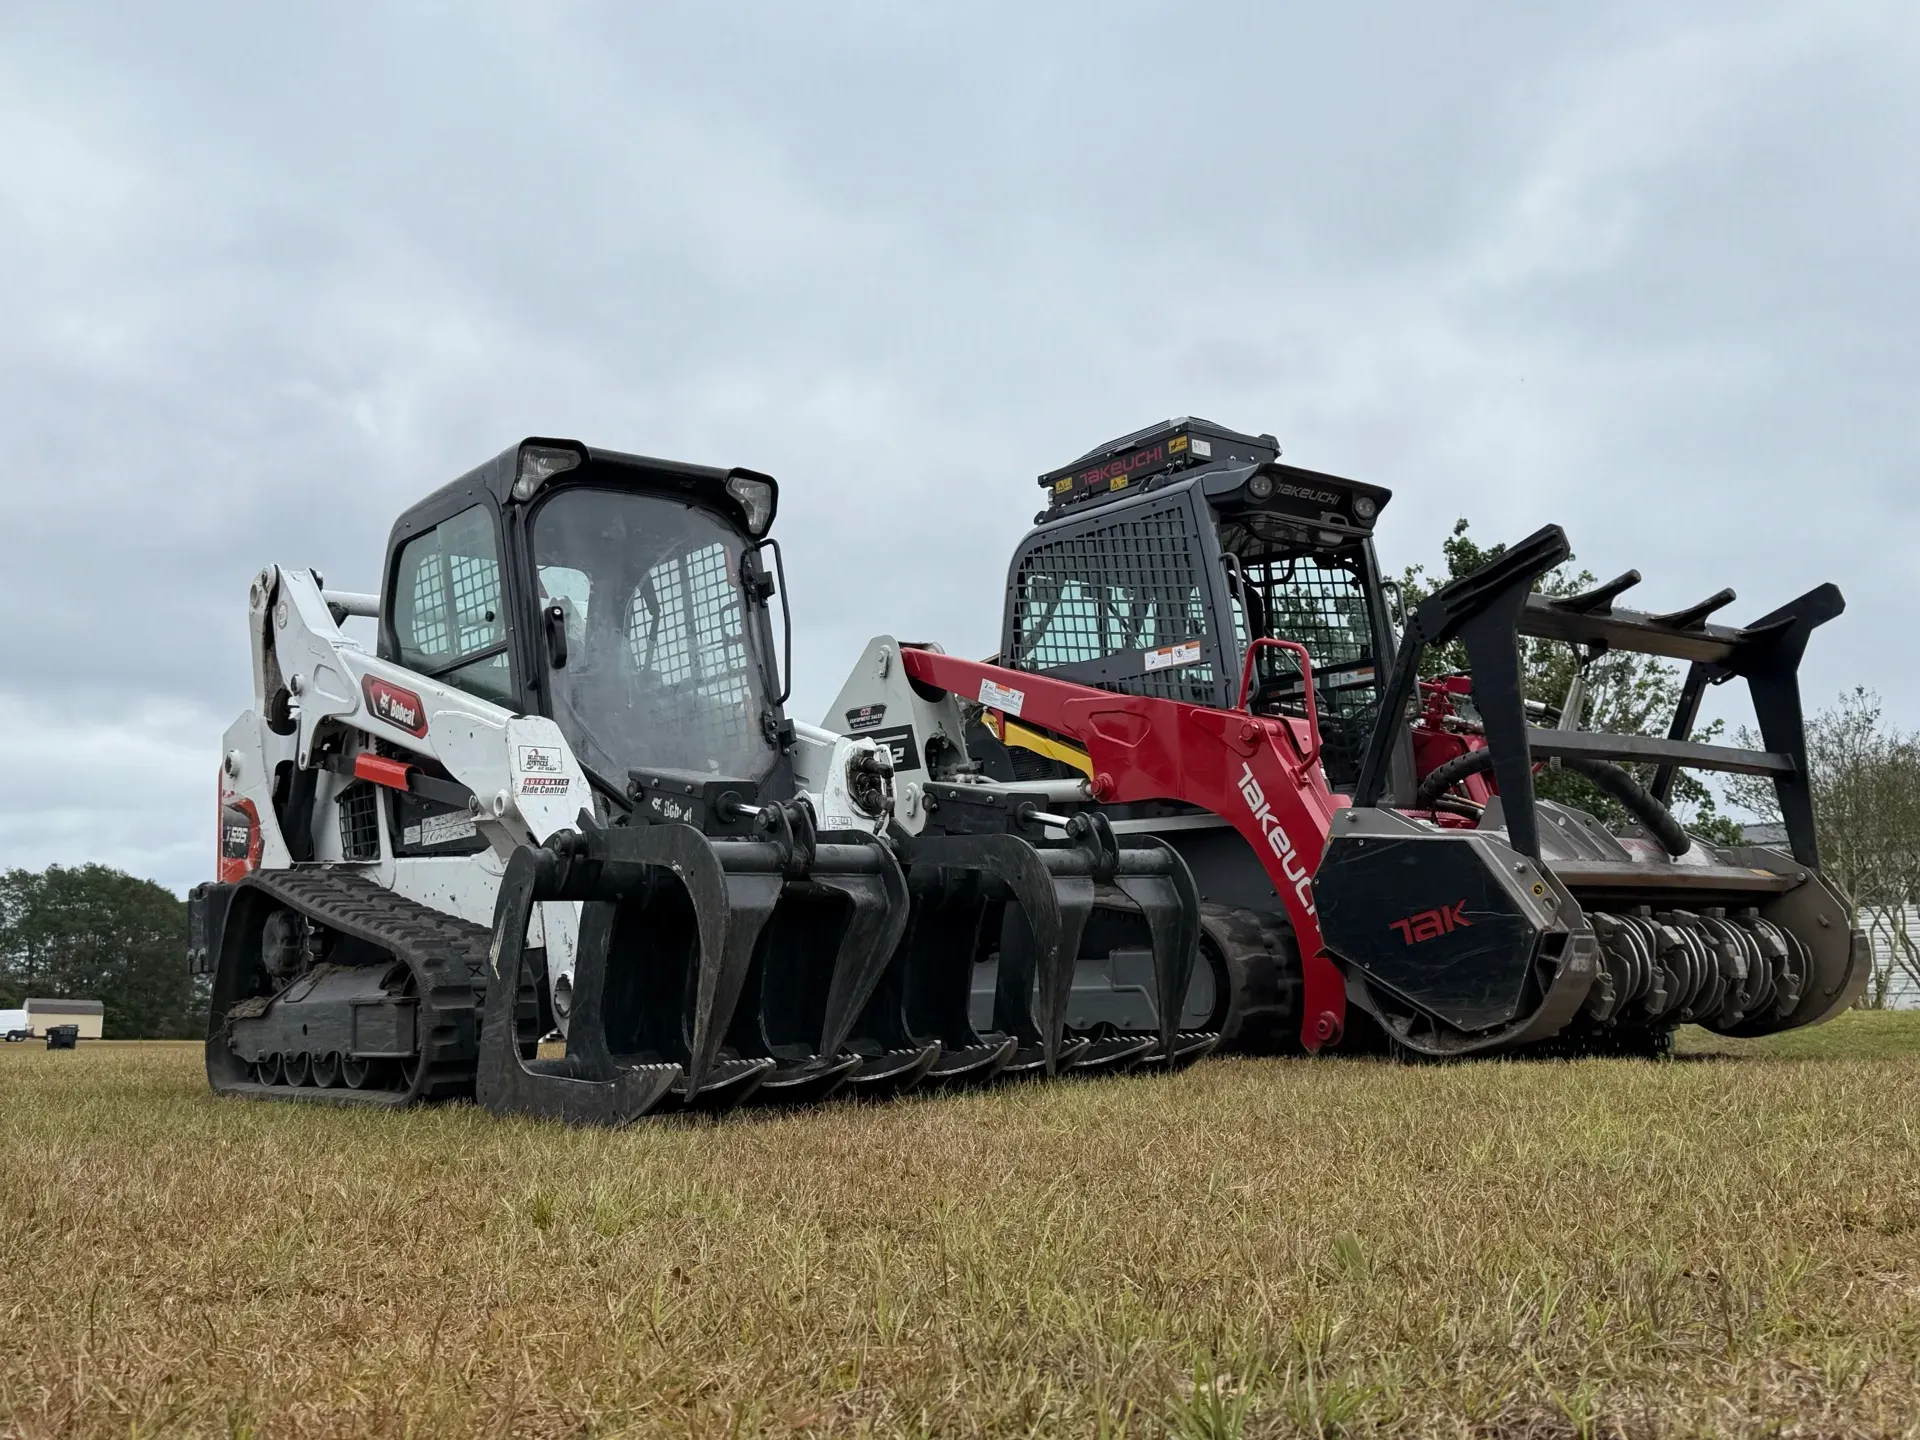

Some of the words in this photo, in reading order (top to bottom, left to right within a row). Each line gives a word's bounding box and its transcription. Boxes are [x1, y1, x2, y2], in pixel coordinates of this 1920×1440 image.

[1080, 447, 1162, 485] TAKEUCHI
[1276, 483, 1340, 505] TAKEUCHI
[390, 699, 416, 726] Bobcat
[540, 786, 568, 794] Control
[1237, 761, 1320, 932] TAKEUC
[1388, 899, 1473, 945] TAK
